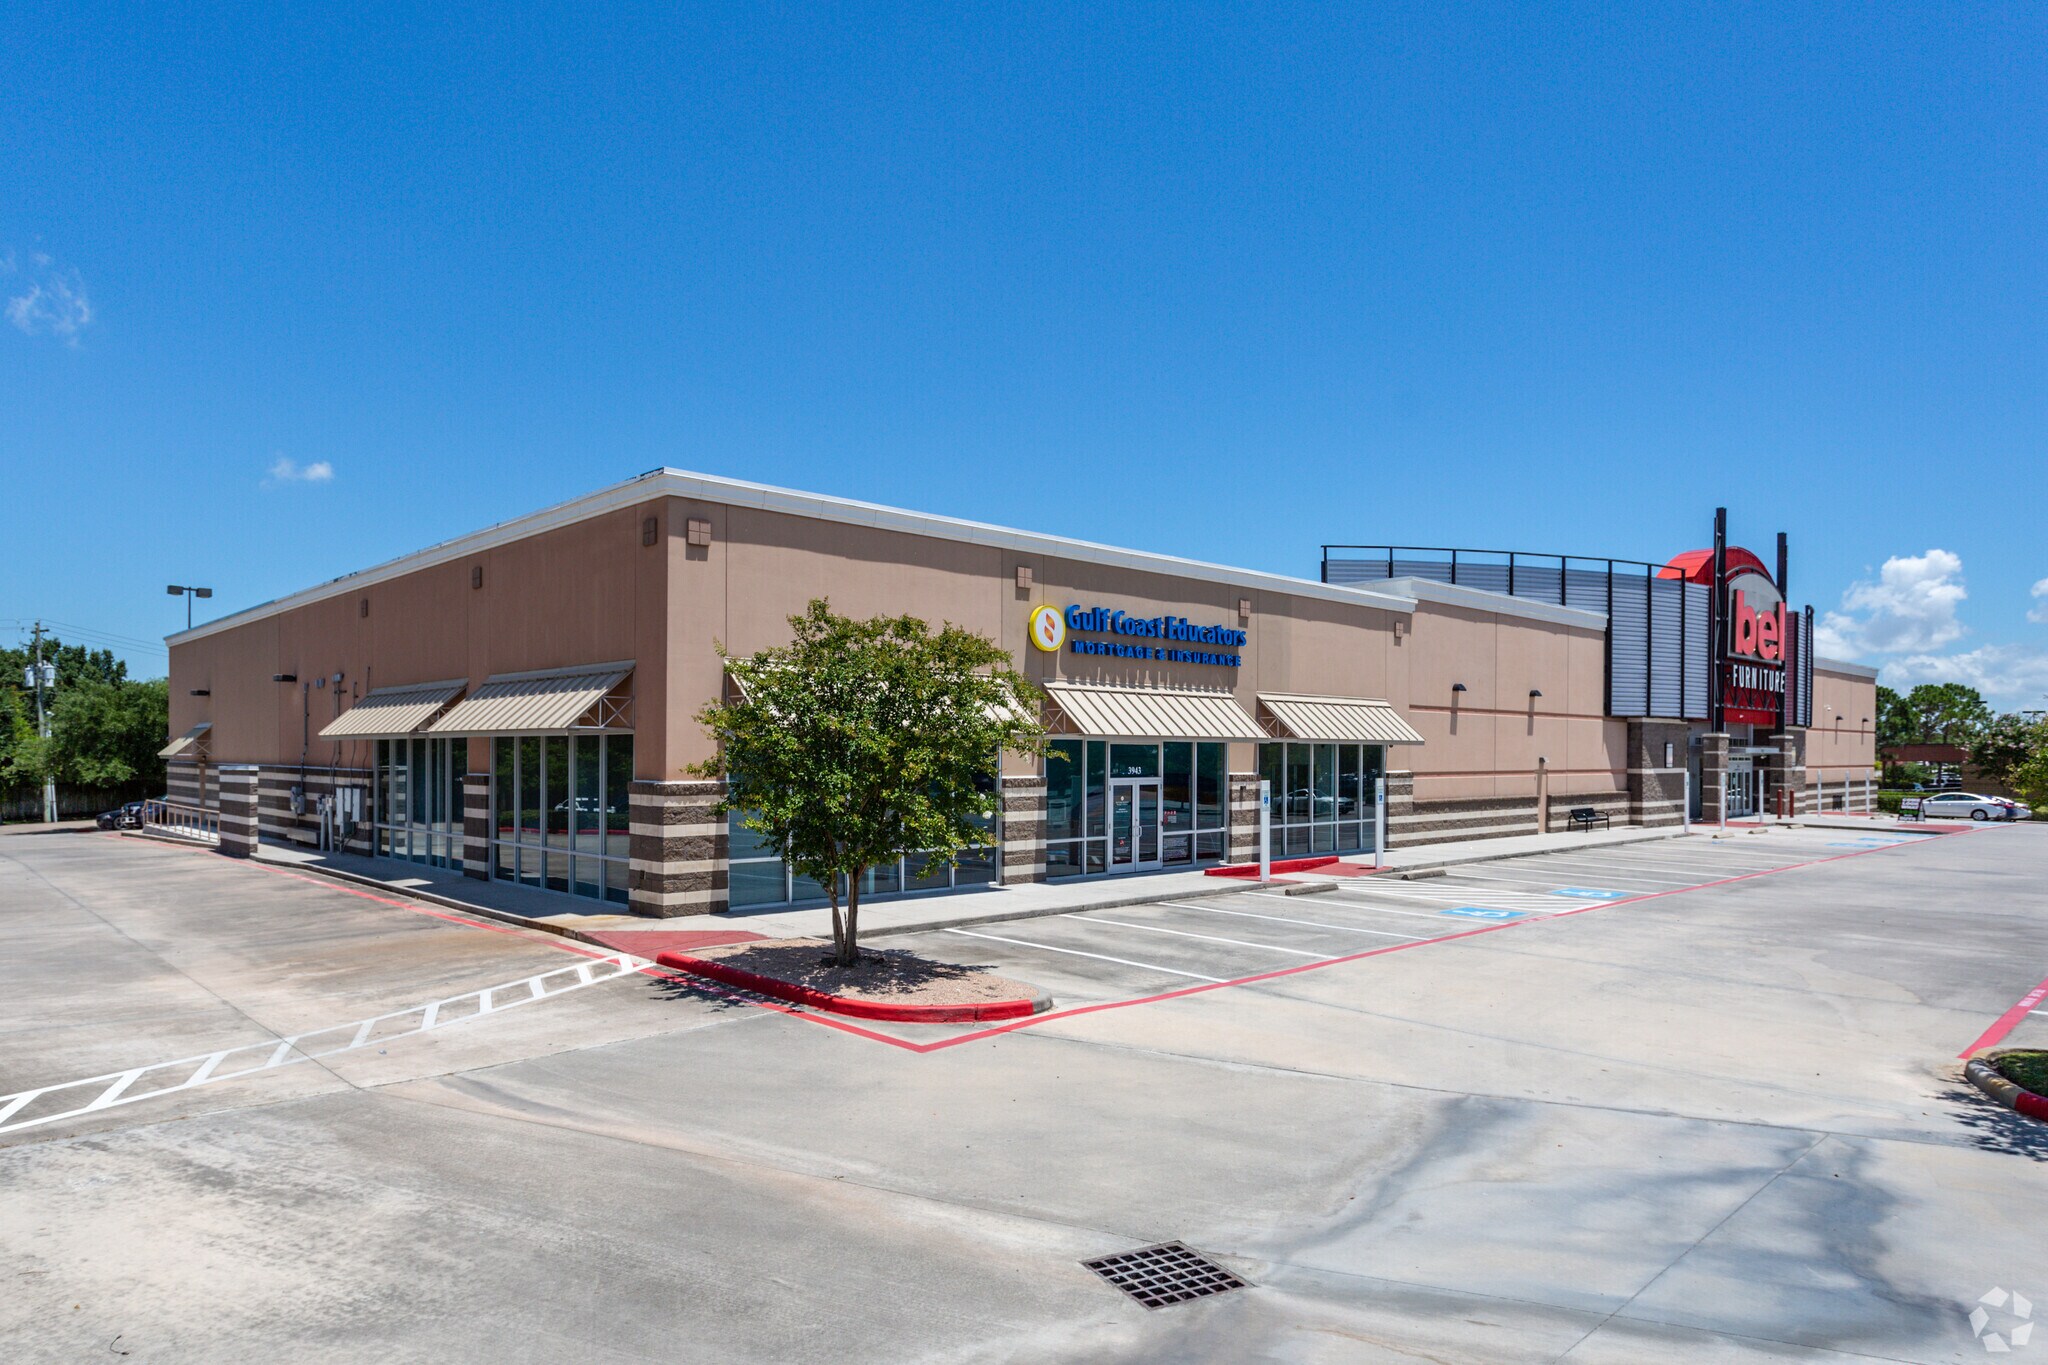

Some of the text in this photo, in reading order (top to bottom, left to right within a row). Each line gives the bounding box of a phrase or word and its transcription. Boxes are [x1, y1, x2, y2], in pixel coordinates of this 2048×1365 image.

[1064, 604, 1247, 647] Gulf Coast Educators
[1734, 589, 1786, 661] bel
[1071, 640, 1242, 667] MORTGAGE & INSURANCE
[1733, 664, 1786, 693] FURNITURE
[1127, 766, 1141, 775] 3943
